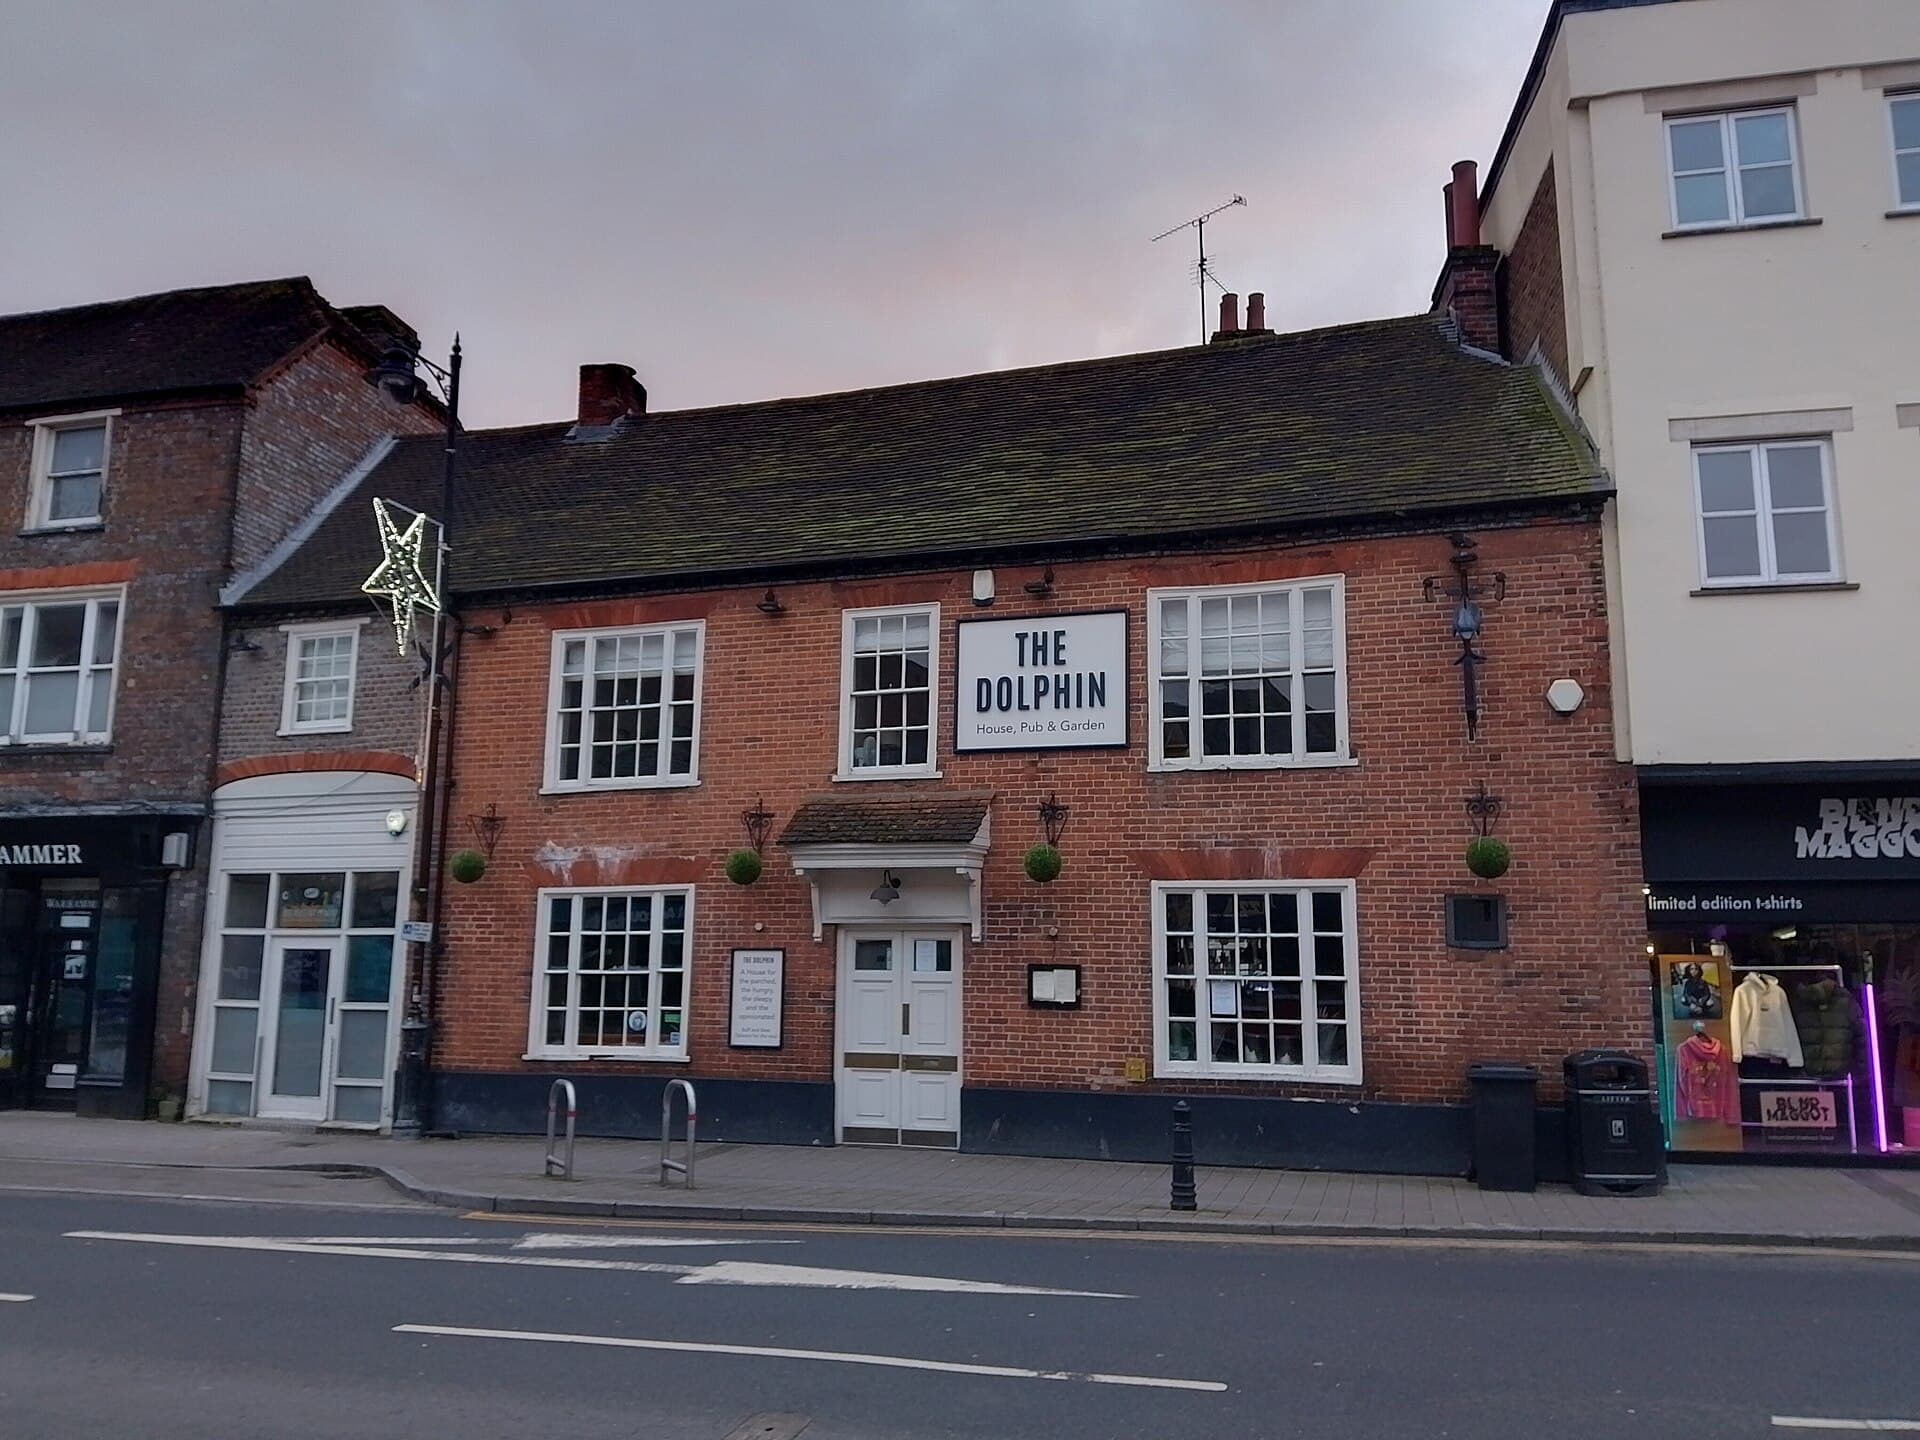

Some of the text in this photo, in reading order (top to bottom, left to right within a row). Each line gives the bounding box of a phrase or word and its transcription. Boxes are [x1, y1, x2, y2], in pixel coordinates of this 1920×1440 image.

[1015, 630, 1066, 667] THE
[976, 671, 1106, 713] DOLPHIN
[976, 719, 1105, 735] House, Pub & Garden
[0, 844, 82, 864] AMMER
[1648, 894, 1803, 910] limited edition t-shirts
